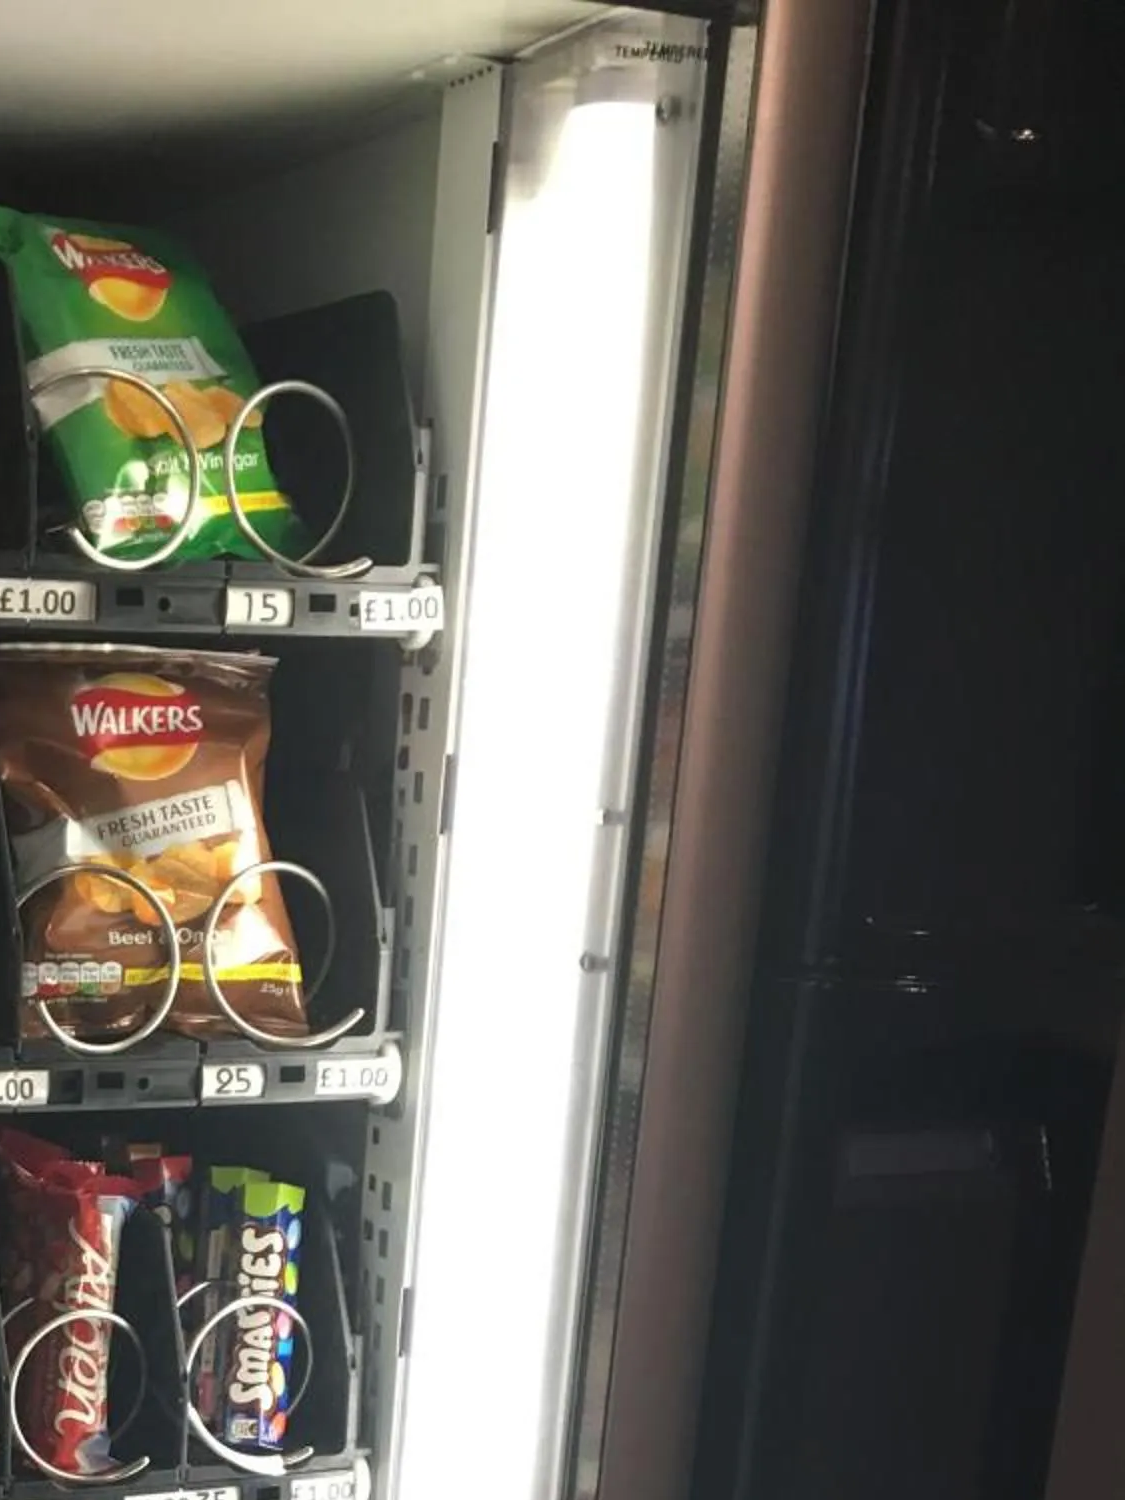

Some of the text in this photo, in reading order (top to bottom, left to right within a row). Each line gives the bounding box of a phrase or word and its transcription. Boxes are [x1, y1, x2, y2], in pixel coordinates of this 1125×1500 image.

[109, 343, 188, 361] FRESH TASTE
[197, 452, 260, 472] Vingar
[242, 593, 280, 621] 15
[363, 595, 439, 622] £1.00
[71, 701, 204, 737] WALKERS
[96, 795, 215, 841] FRESH TASTE
[121, 811, 217, 849] GUARANTEED
[108, 929, 152, 946] Beef
[177, 928, 232, 946] Onon
[216, 1067, 251, 1095] 25
[319, 1066, 389, 1089] £1.00
